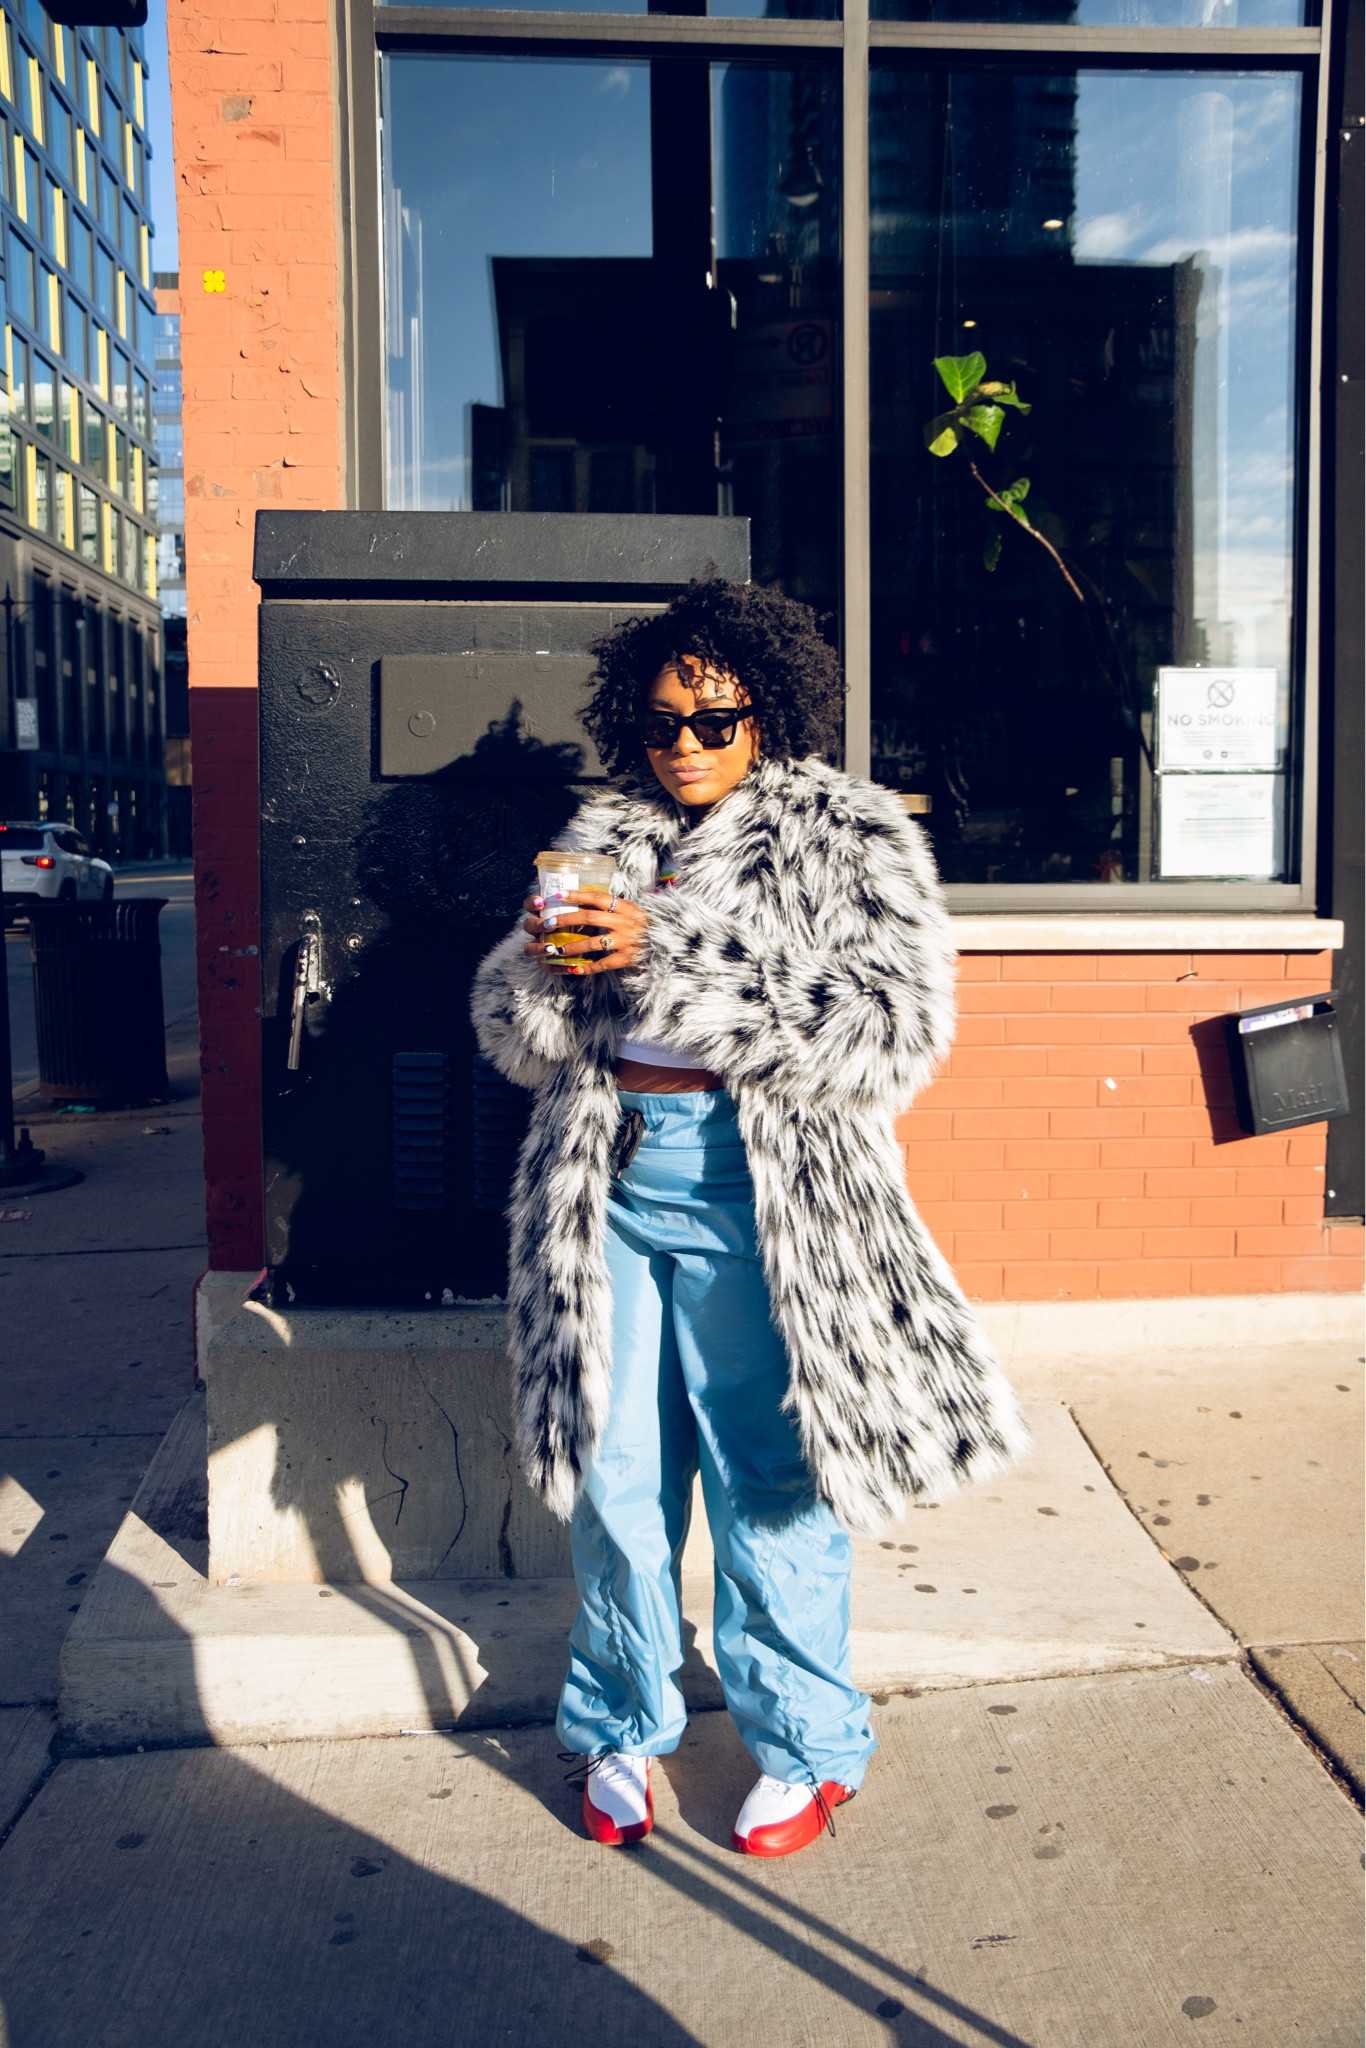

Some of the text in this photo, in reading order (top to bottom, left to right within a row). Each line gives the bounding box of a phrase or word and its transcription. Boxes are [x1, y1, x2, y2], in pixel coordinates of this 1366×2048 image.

[1167, 714, 1277, 726] NO SMOKING
[1272, 1082, 1328, 1112] Mail
